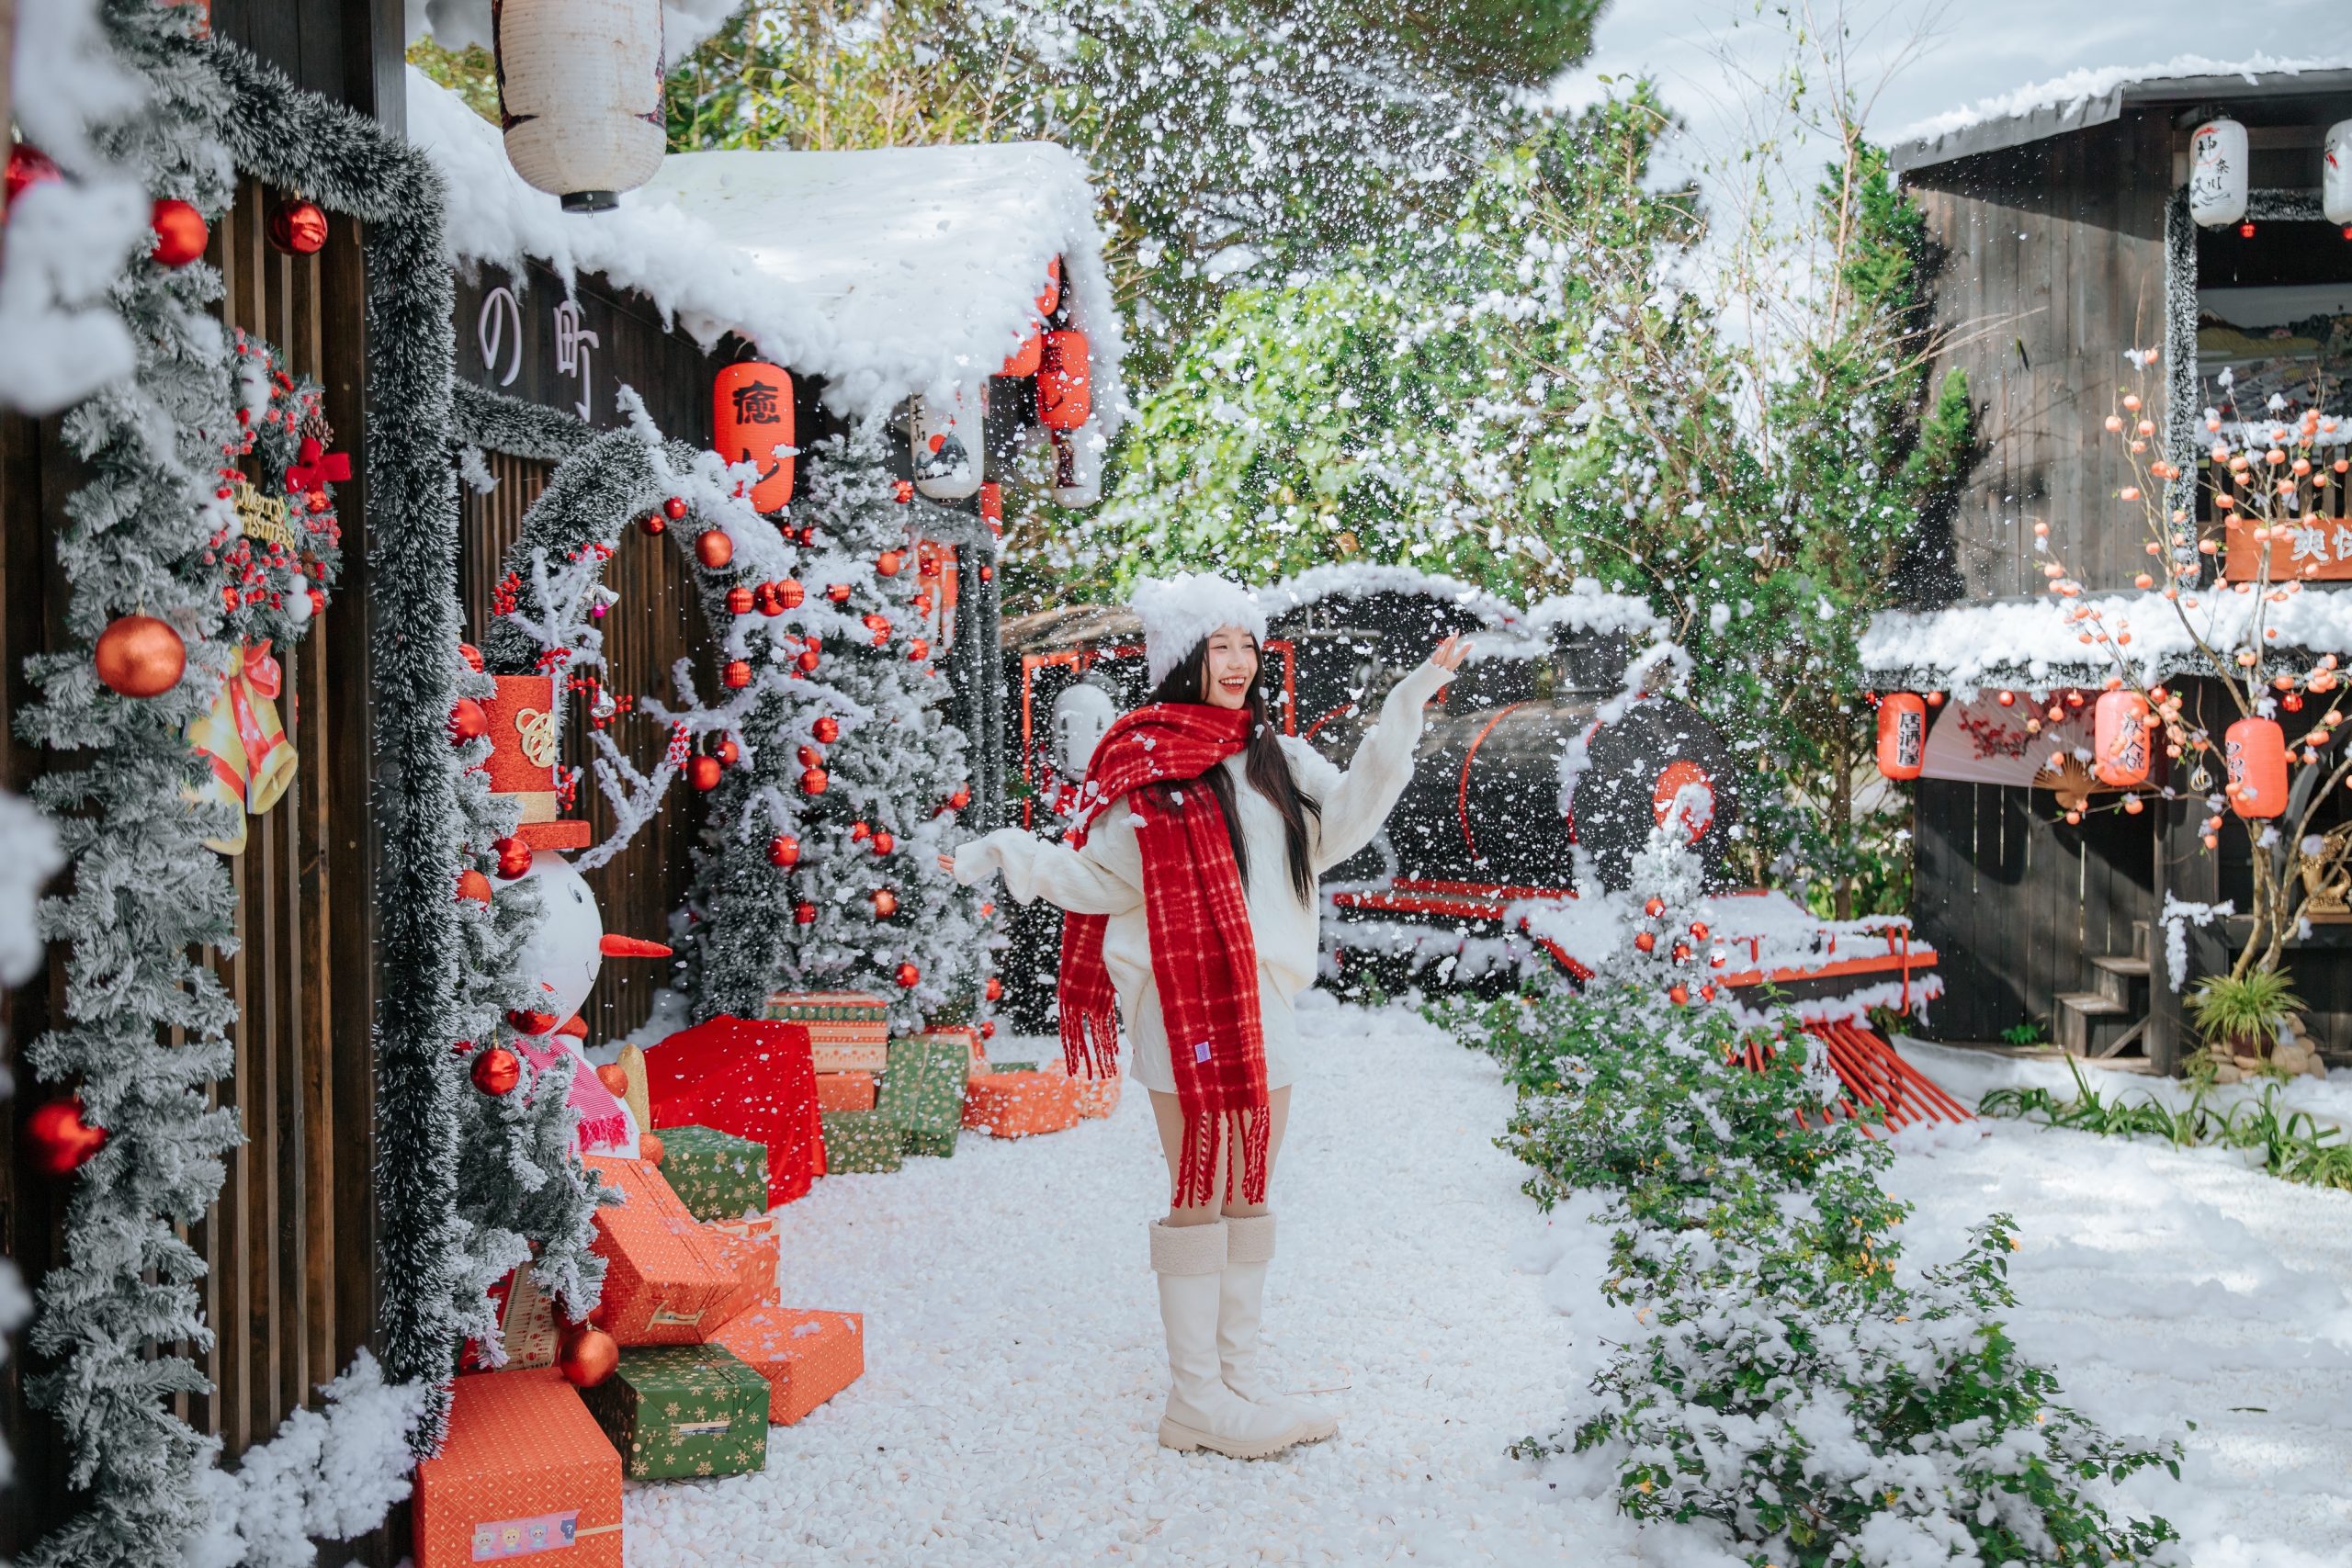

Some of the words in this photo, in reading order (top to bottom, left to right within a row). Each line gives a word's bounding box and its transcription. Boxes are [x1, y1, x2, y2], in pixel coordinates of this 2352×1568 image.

[478, 287, 600, 423] の町
[1898, 712, 1921, 766] 居酒屋
